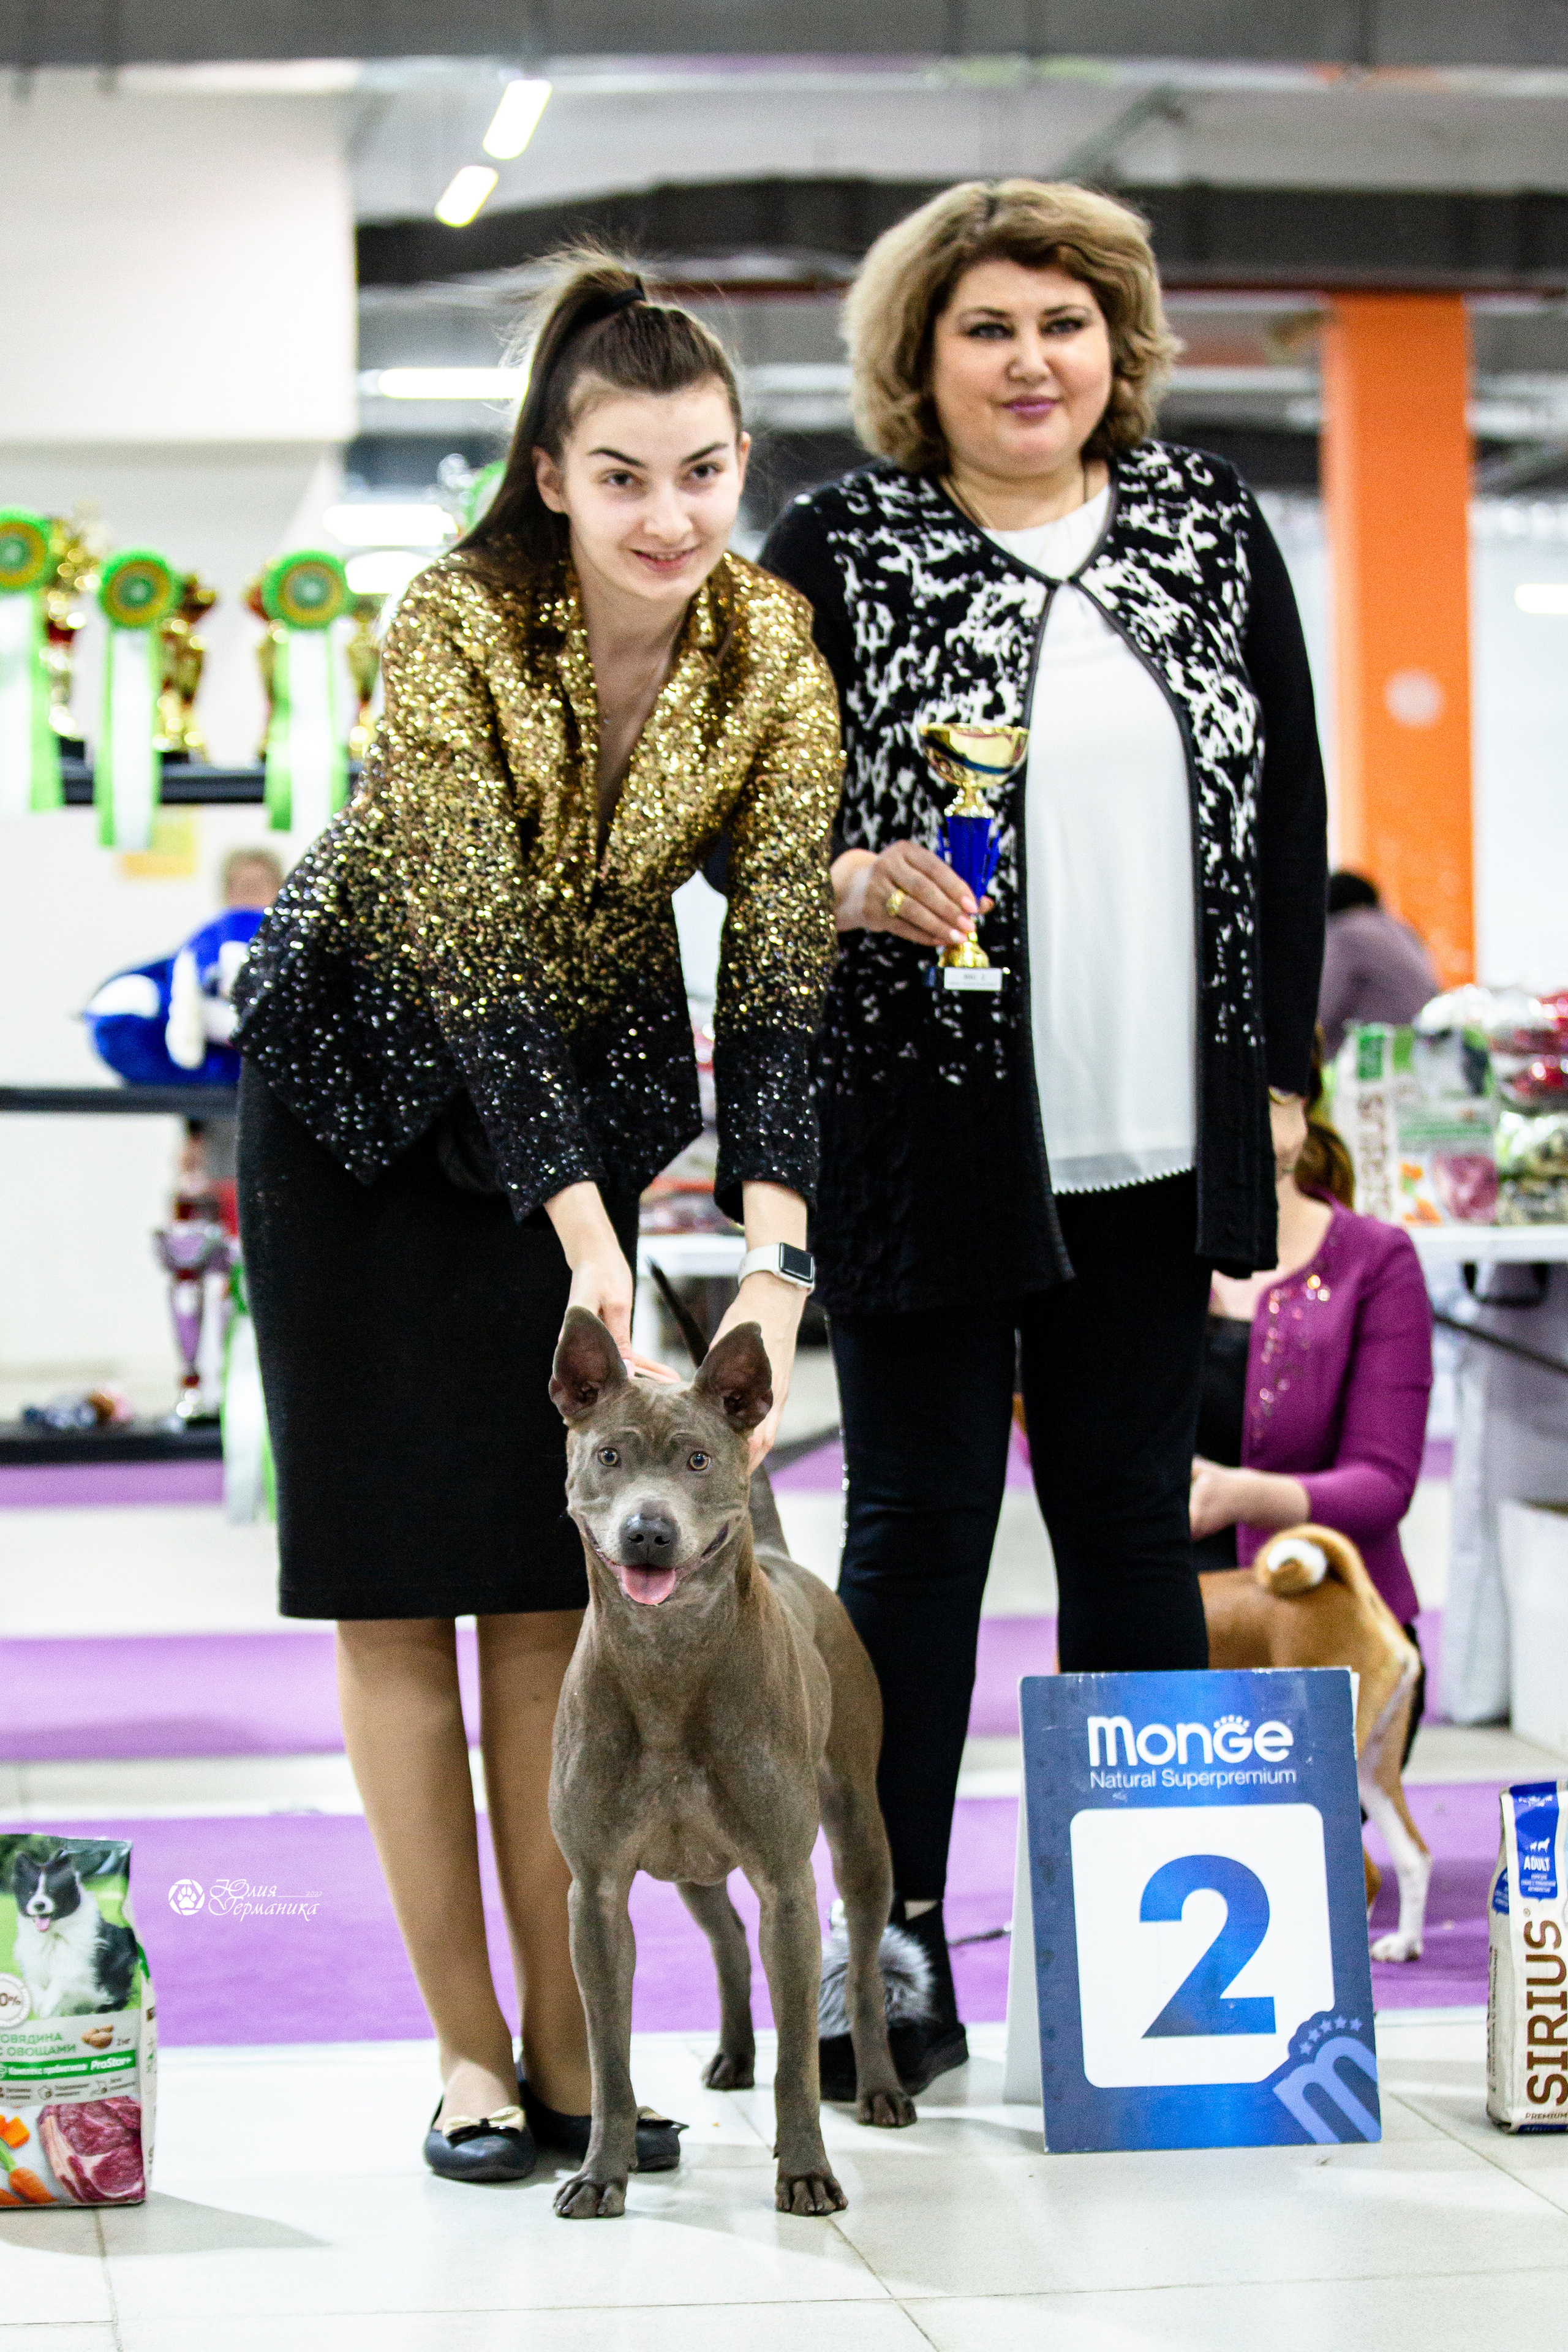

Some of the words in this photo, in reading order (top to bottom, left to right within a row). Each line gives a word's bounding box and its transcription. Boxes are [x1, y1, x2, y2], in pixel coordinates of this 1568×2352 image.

[1090, 1770, 1156, 1789] Natural
[1161, 1768, 1297, 1790] Superpremium
[1523, 1855, 1550, 1872] ADULT
[1139, 1854, 1276, 2038] 2
[1523, 1920, 1568, 2106] SIRIUS
[7, 2043, 76, 2056] ОВОЩАМИ
